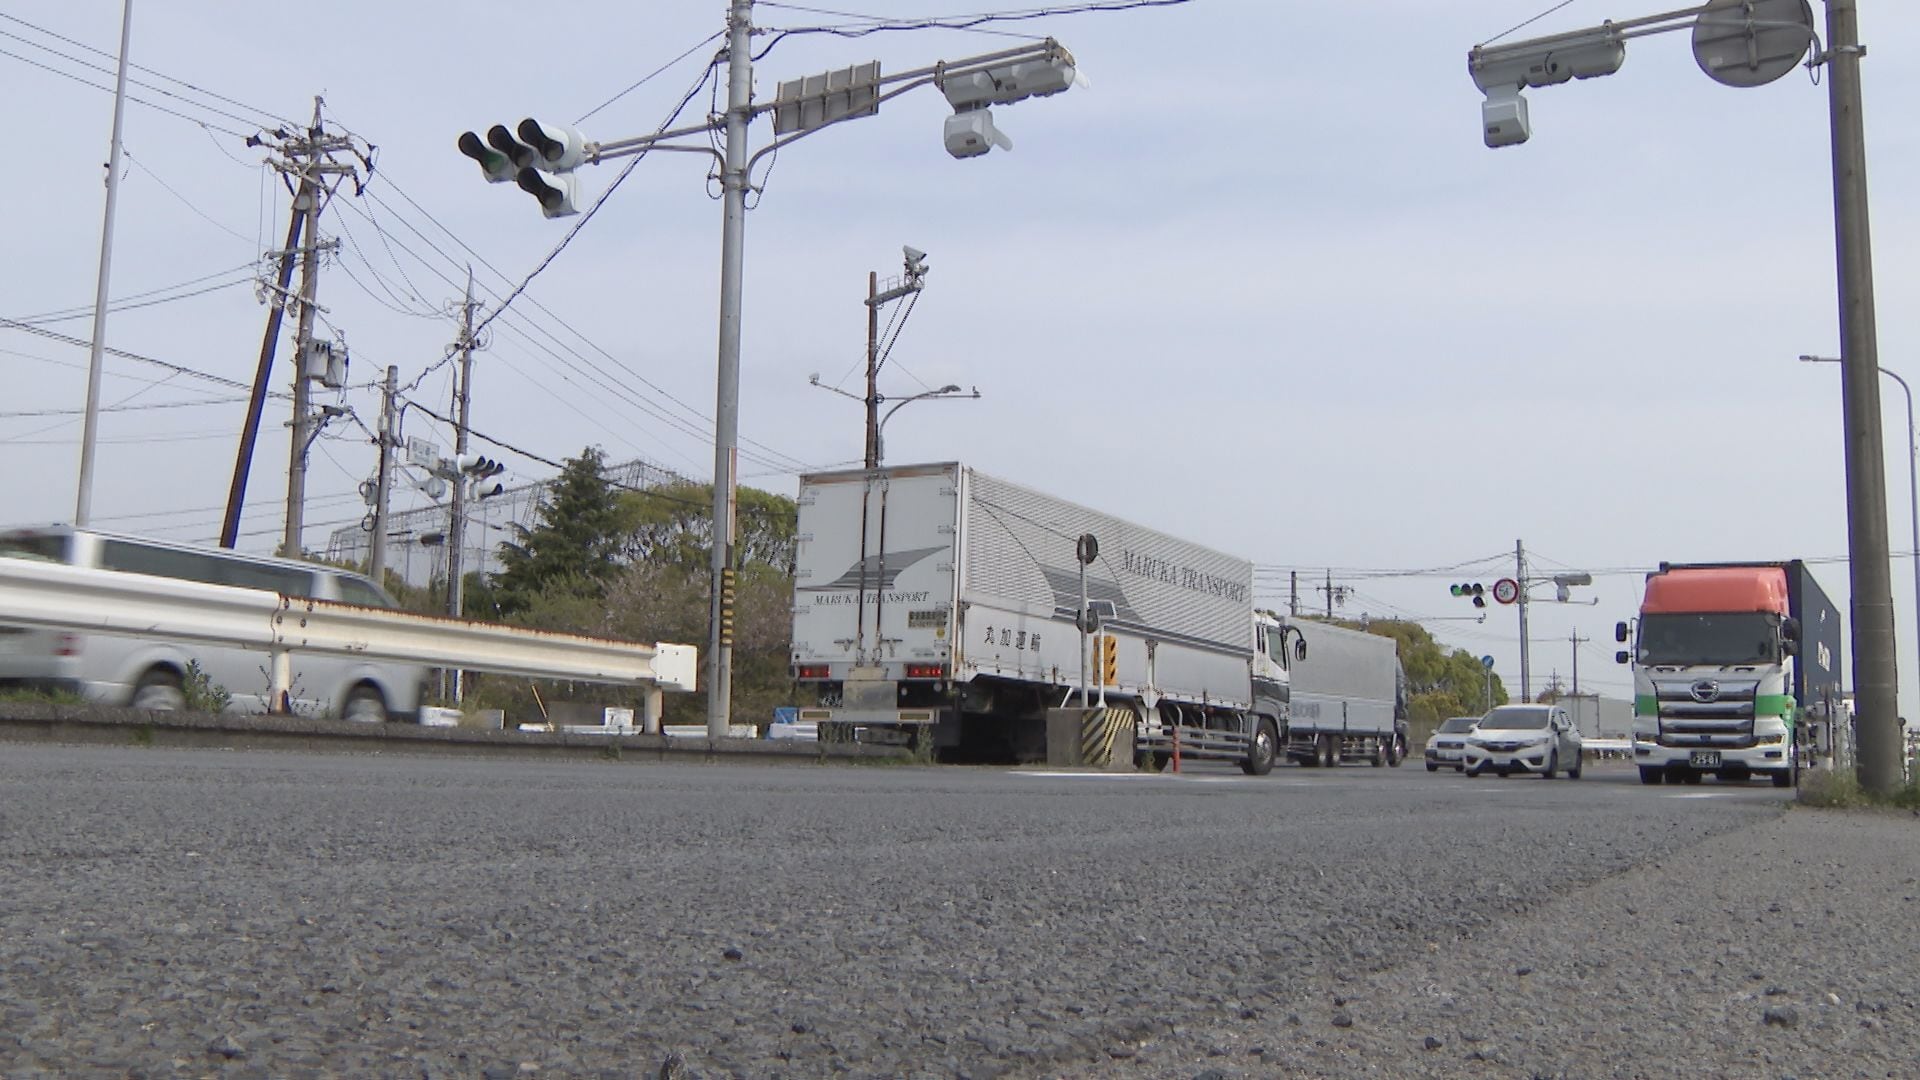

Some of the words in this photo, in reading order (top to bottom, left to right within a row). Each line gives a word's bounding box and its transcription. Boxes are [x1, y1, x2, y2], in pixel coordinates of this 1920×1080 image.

[1121, 550, 1177, 585] MARUKA
[1182, 567, 1247, 602] TRANSPORT
[815, 594, 862, 605] MARUKA
[865, 591, 930, 604] TRANSPORT
[984, 626, 1041, 652] 丸加運輸
